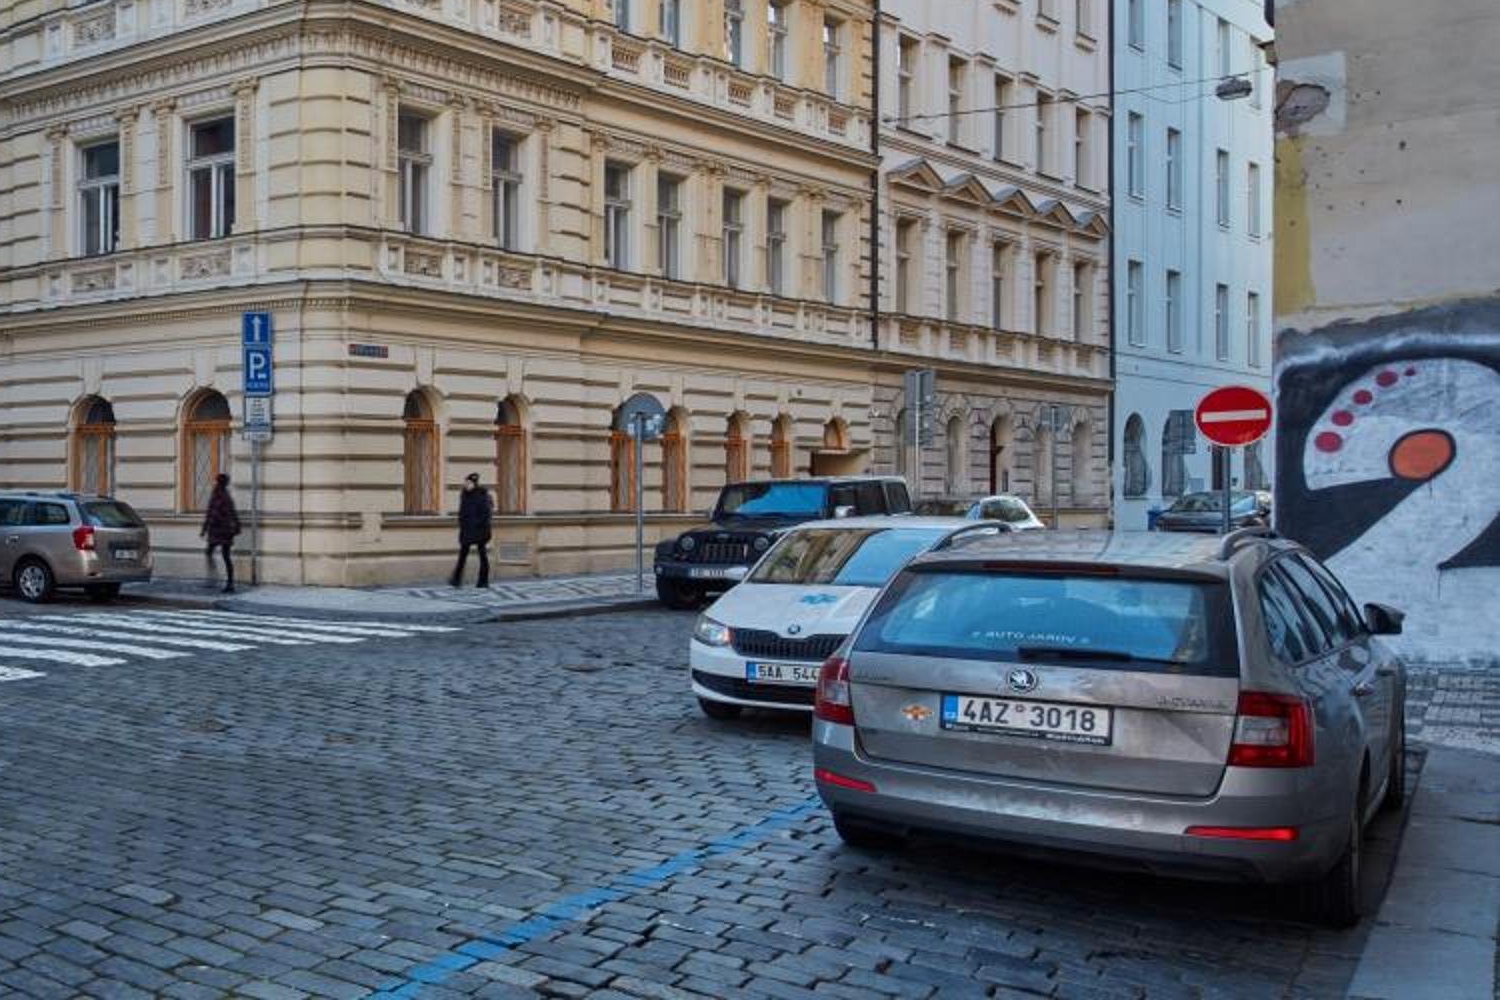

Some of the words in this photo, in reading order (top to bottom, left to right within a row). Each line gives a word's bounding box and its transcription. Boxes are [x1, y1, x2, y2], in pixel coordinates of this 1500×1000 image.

[249, 352, 265, 379] P
[793, 667, 817, 681] 544
[963, 700, 1009, 725] 4AZ
[1030, 706, 1096, 732] 3018
